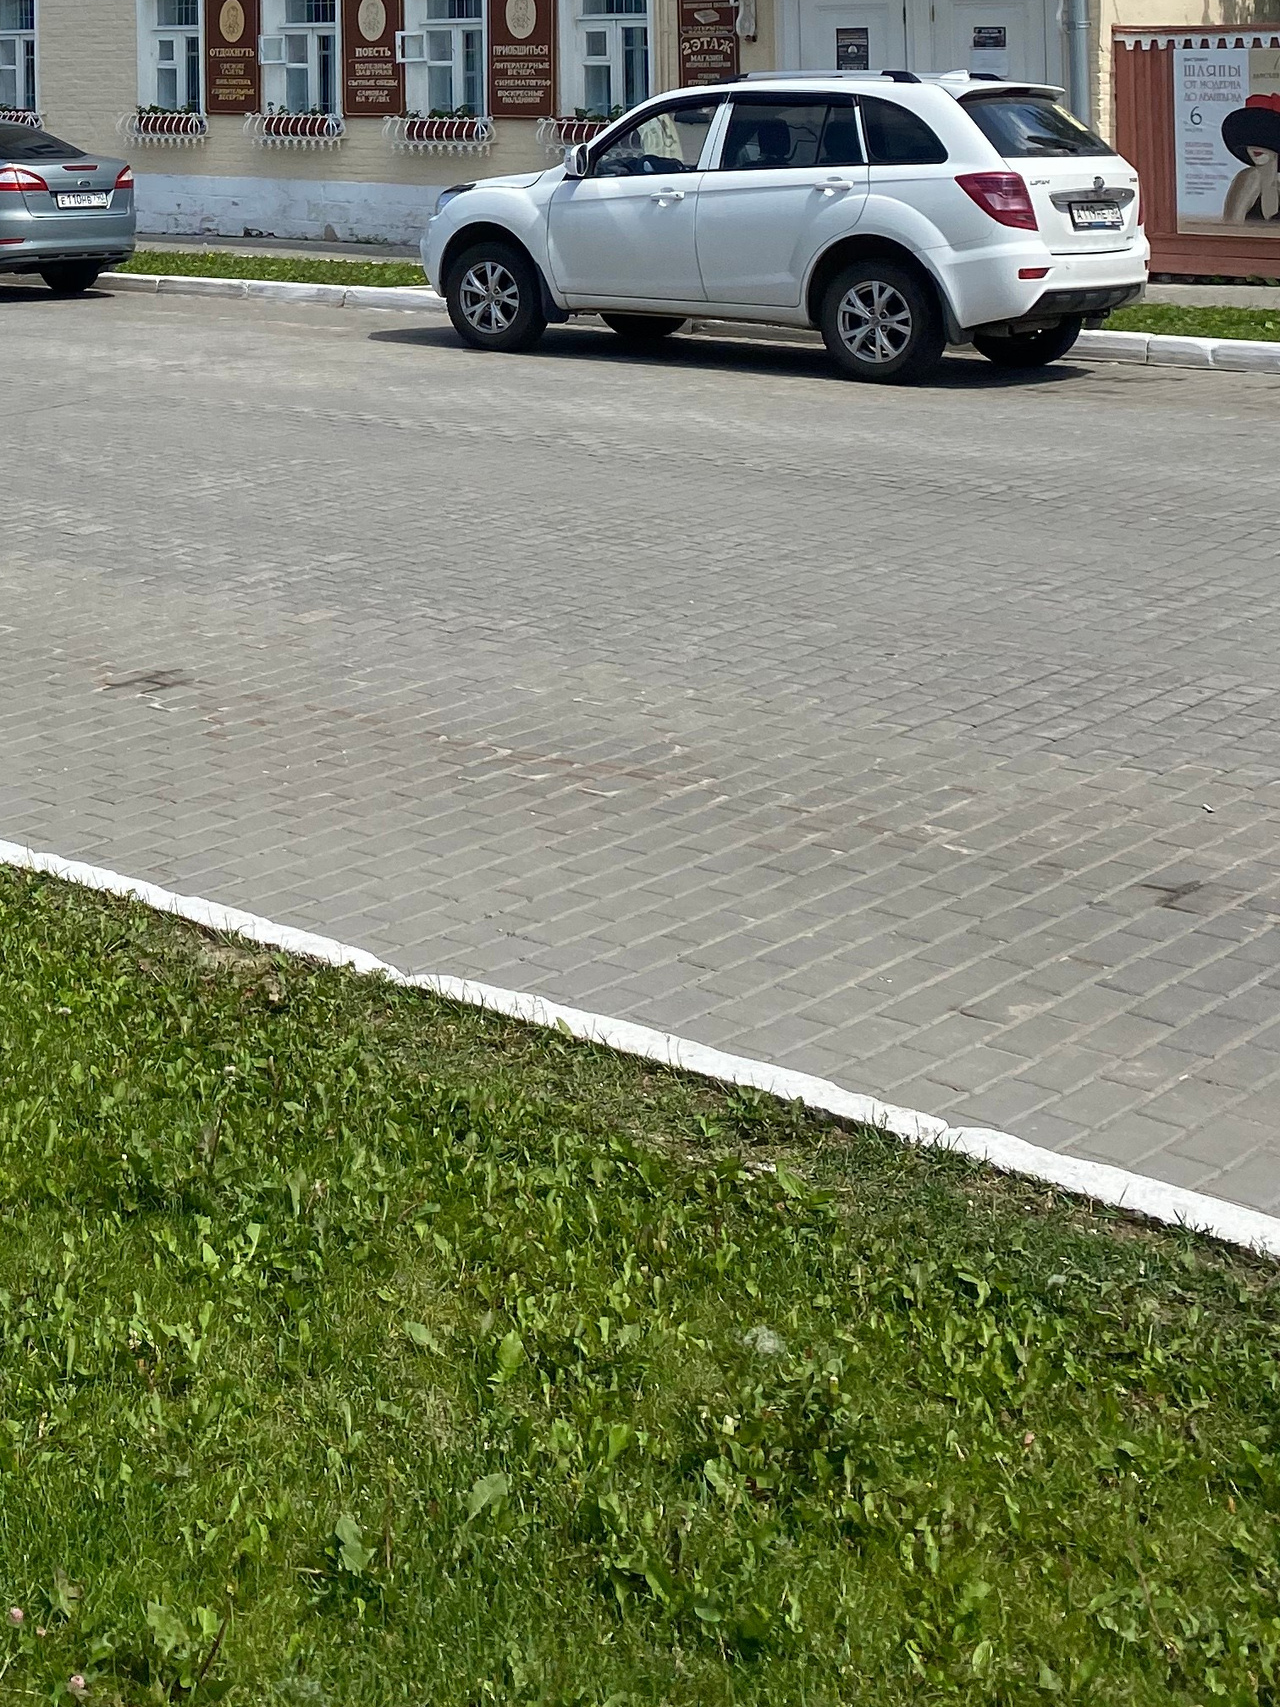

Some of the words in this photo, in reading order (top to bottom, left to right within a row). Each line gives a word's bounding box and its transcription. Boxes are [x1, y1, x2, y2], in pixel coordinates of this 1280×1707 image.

[209, 47, 255, 58] ОТДОХНУТЬ
[355, 47, 392, 58] ПОЕСТЬ
[690, 54, 724, 62] МАГАЗИН
[493, 62, 550, 70] ЛИТЕРАТУРНЫЕ
[1183, 65, 1241, 77] ШЛЯПЫ
[494, 79, 552, 87] СИНЕМАТОГРАФ
[1183, 81, 1198, 90] ОТ
[1199, 80, 1242, 91] МОДЕРНА
[1183, 92, 1198, 102] ДО
[1198, 92, 1243, 103] АВАНГАРДА
[1190, 106, 1203, 125] 6
